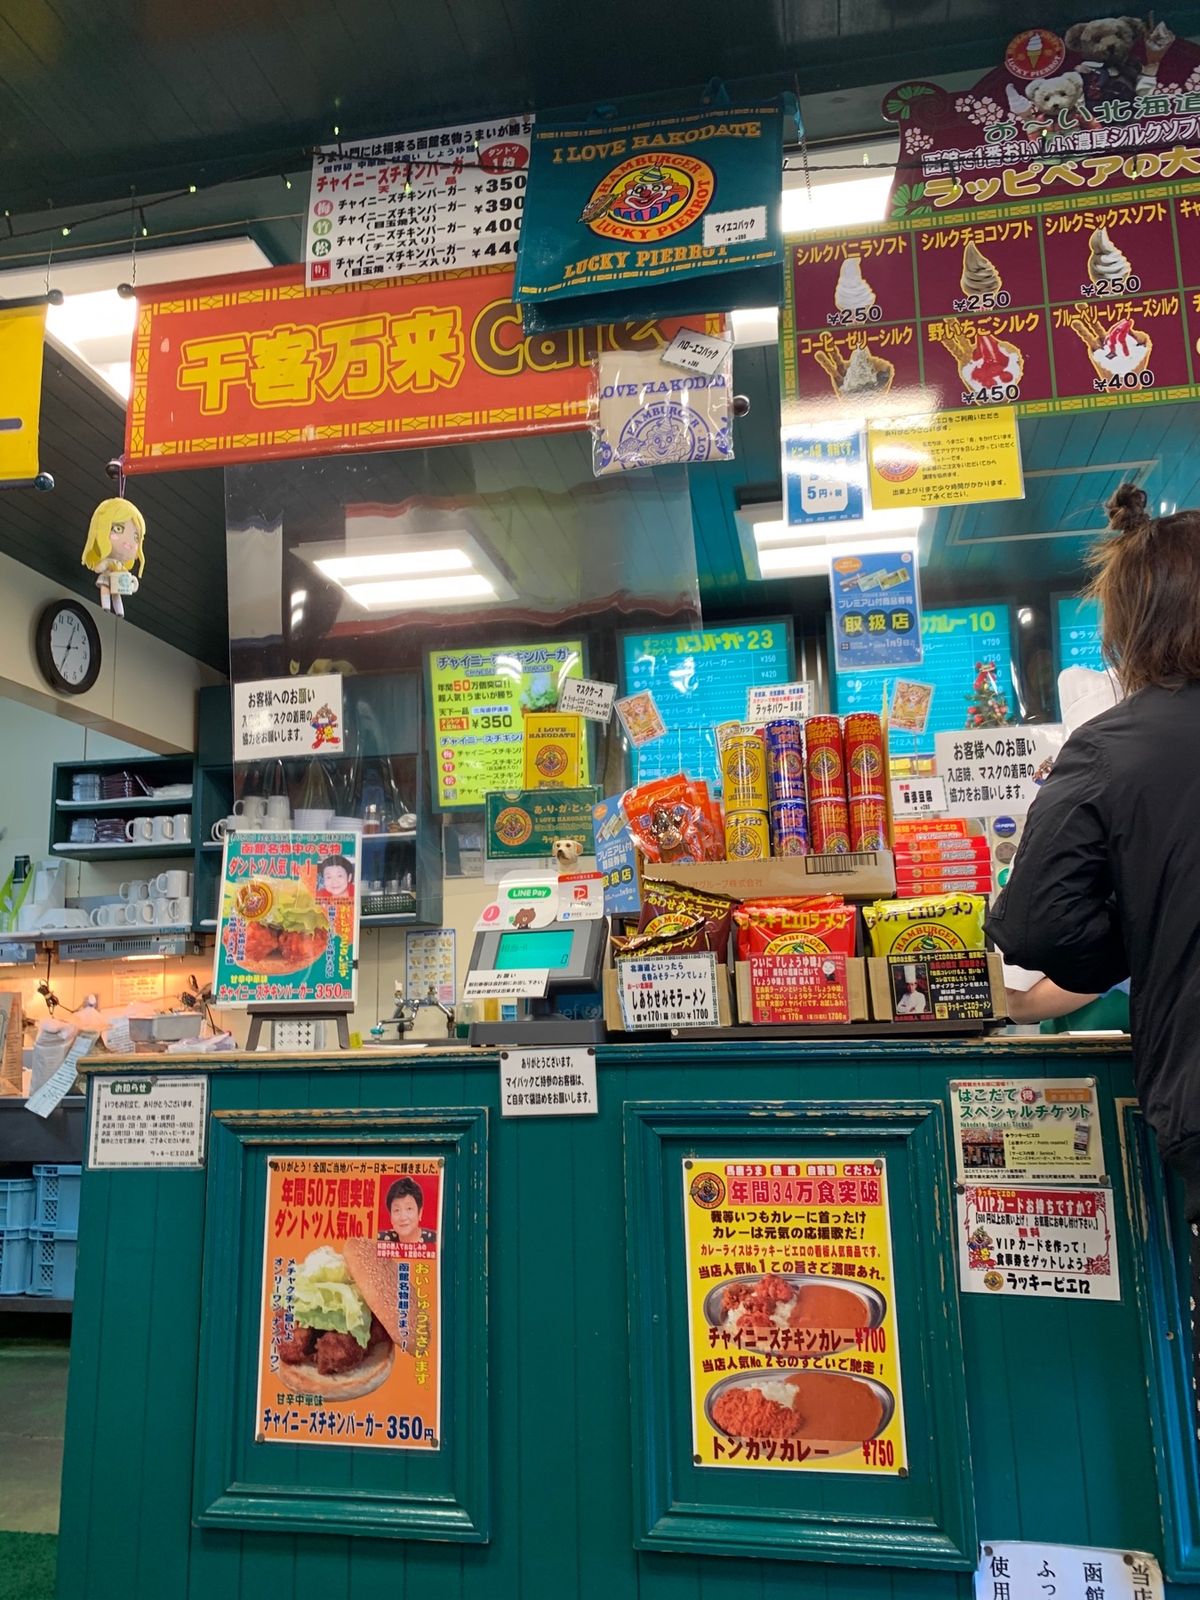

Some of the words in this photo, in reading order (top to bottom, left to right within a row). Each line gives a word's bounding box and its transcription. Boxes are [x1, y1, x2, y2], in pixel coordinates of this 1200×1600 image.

[565, 141, 627, 161] LOVE
[631, 121, 761, 148] HAKODATE
[922, 116, 1200, 176] 函館で1番おいしい濃厚シルクソフ
[598, 152, 703, 193] HAMBURGER
[378, 176, 457, 194] 天一品
[474, 175, 527, 194] ¥350
[338, 185, 467, 210] チャイニーズチキンバーガー
[474, 196, 525, 214] ¥390
[337, 201, 467, 226] チャイニーズチキンバーガー
[595, 218, 652, 241] LUCKY
[655, 179, 711, 237] PIERROT
[1045, 202, 1167, 236] シルクミックスソフト
[336, 223, 467, 248] チャイニーズチキンバーガー
[921, 224, 1033, 250] シルクチョコソフト
[335, 245, 467, 270] チャイニーズチキンバーガー
[796, 235, 908, 265] シルクバニラソフト
[563, 249, 630, 280] LUCKY
[1080, 275, 1141, 297] ¥250
[953, 291, 1011, 312] ¥250
[1052, 296, 1179, 329] ブルーベリーレアチーズシルク
[826, 306, 882, 325] ¥250
[927, 312, 1041, 342] 野いちごシルク
[177, 306, 464, 416] 千客万来
[600, 383, 639, 399] OVE
[1093, 370, 1155, 391] ¥400
[961, 384, 1020, 404] ¥450
[844, 612, 910, 634] 取扱店
[968, 611, 996, 632] 10
[747, 629, 774, 650] 23
[247, 687, 316, 709] お客様へのお願い
[472, 714, 513, 729] ¥350
[953, 737, 1037, 762] お客様へのお願い
[947, 763, 1035, 784] 入店時、マスクの着用の
[949, 784, 1026, 803] 協力をお願いします。
[512, 889, 532, 897] LINE
[532, 888, 547, 898] Pay
[895, 925, 960, 953] HAMBURGER
[629, 962, 684, 973] 北海道といったら
[631, 988, 706, 1010] しあわせみそラーメン
[521, 1055, 574, 1069] ありがとうございます。
[114, 1083, 147, 1093] お知らせ
[506, 1091, 592, 1106] ご自身で袋詰めをお願いします。
[958, 1087, 1018, 1103] はこだて
[959, 1104, 1091, 1120] スペシャルチケット
[281, 1177, 376, 1209] 年間50万個突破
[730, 1180, 881, 1205] 年間34万食突破
[977, 1196, 1093, 1216] VIPカードお持ちですか?
[712, 1226, 865, 1240] カレーは元気の応援歌だ!
[1018, 1227, 1041, 1238] 無料
[1006, 1272, 1091, 1295] ラッキーピエロ
[708, 1327, 855, 1351] チャイニーズチキンカレー
[855, 1326, 887, 1354] ¥700
[263, 1408, 383, 1438] チャイニーズチキンバーガー
[386, 1414, 434, 1441] 350円
[712, 1435, 830, 1463] トンカツカレー
[862, 1439, 894, 1467] ¥750
